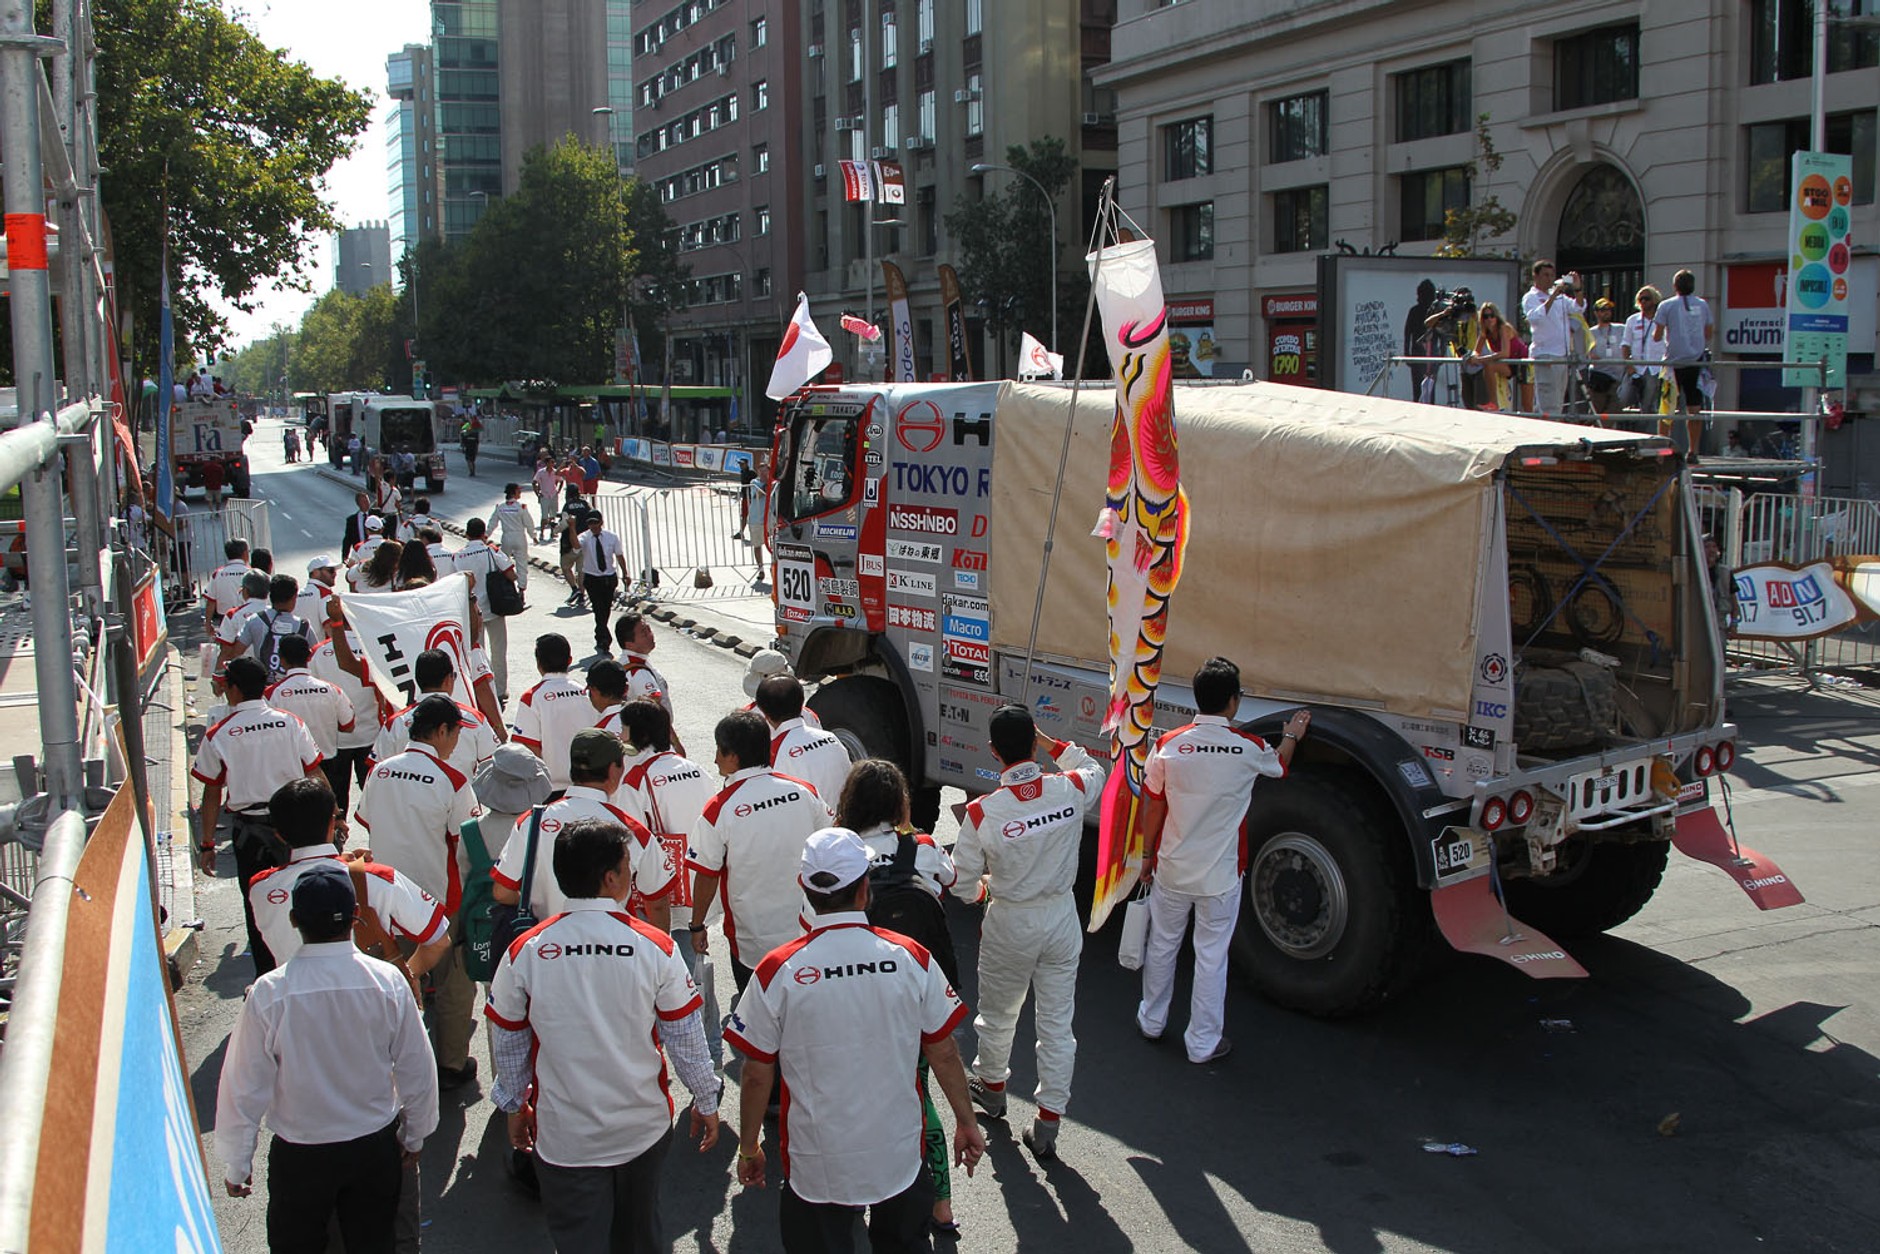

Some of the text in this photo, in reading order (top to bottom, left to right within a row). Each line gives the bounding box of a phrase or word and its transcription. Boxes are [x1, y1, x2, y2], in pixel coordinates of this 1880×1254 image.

[1195, 305, 1210, 315] KING
[1276, 301, 1303, 312] BURGER
[953, 412, 992, 446] H
[193, 423, 223, 452] Fa
[893, 462, 969, 496] TOKYO
[820, 528, 855, 536] MICHELIN
[866, 560, 883, 571] BUS
[783, 568, 811, 603] 520
[911, 580, 934, 590] LINE
[1769, 578, 1818, 606] ADN
[943, 595, 989, 612] dakar.com
[1792, 599, 1827, 626] 91.7
[949, 619, 982, 637] Macro
[294, 687, 329, 696] HINO
[1477, 701, 1506, 718] IKC
[245, 720, 286, 734] HINO
[1196, 745, 1243, 755] HINO
[391, 770, 435, 784] HINO
[667, 770, 701, 783] HINO
[1681, 783, 1702, 796] HINO
[754, 791, 800, 812] HINO
[1027, 806, 1075, 829] HINO
[1452, 842, 1470, 862] 520
[1755, 874, 1785, 890] HINO
[565, 944, 635, 957] HINO
[1526, 951, 1565, 962] HINO
[824, 961, 898, 980] HINO
